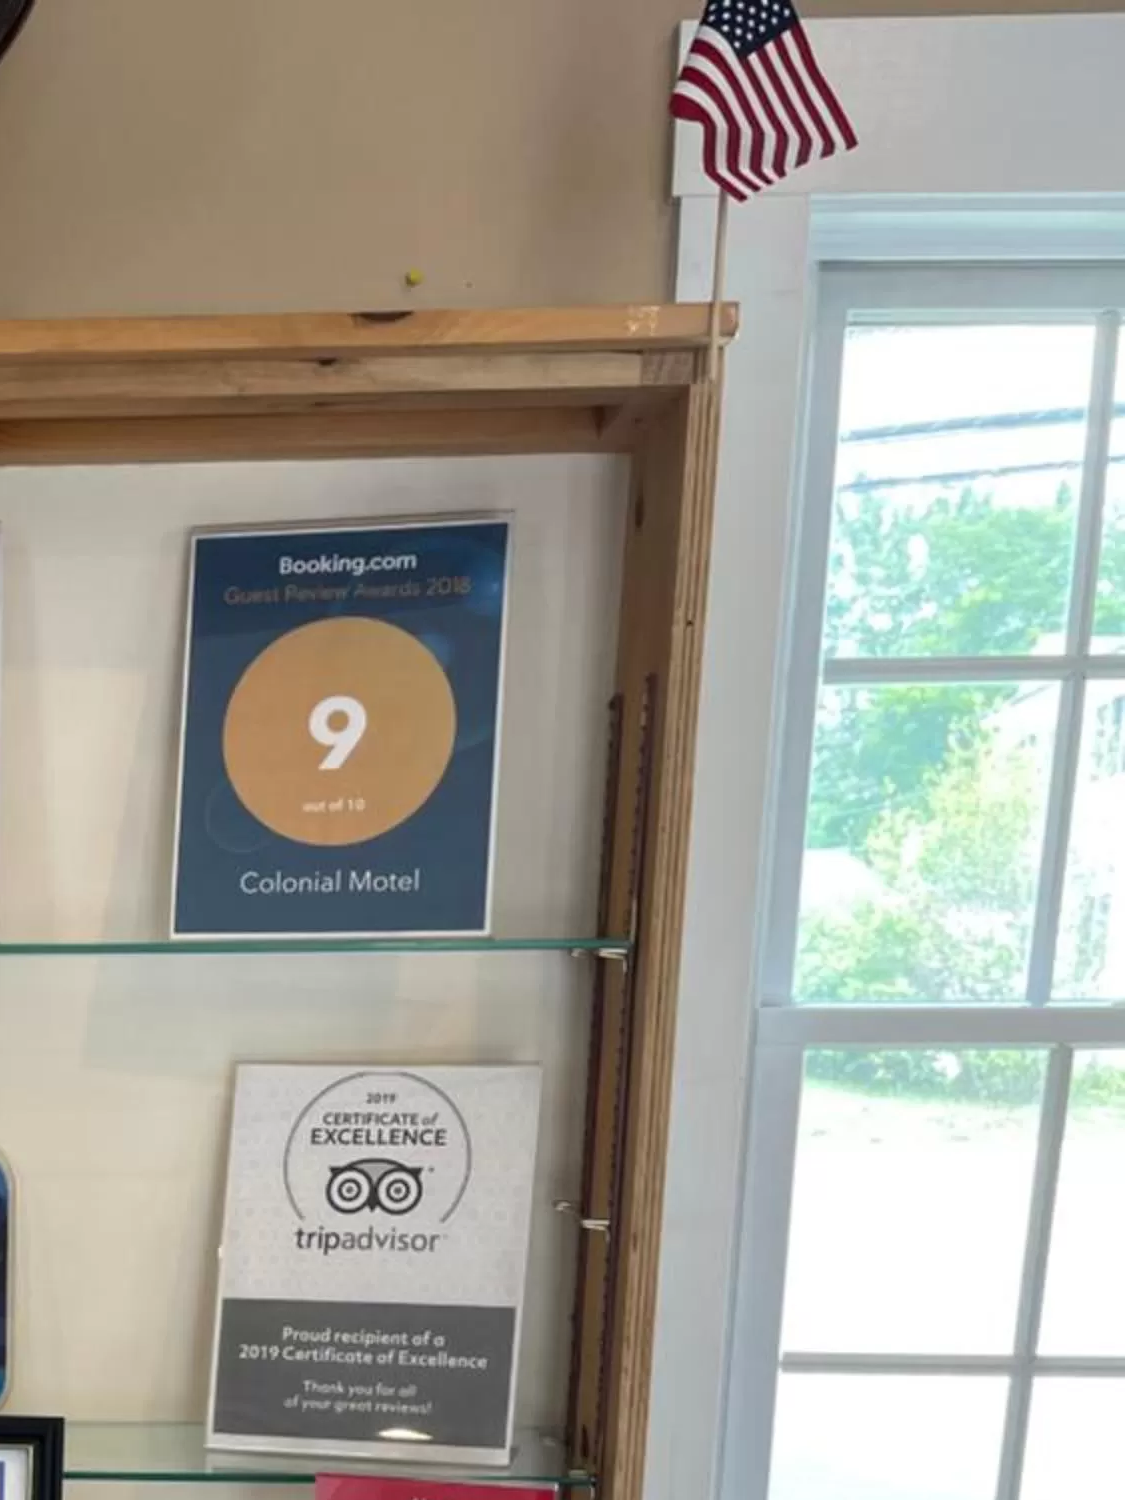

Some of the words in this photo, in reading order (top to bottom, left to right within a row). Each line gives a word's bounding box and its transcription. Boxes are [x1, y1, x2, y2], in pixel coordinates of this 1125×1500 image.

[279, 553, 417, 576] Booking.com
[224, 586, 278, 606] Guest
[284, 583, 350, 604] Review
[353, 579, 421, 600] Awards
[308, 695, 368, 772] 9
[239, 871, 341, 894] Colonial
[348, 869, 420, 893] Motel
[366, 1092, 397, 1105] 2019
[322, 1112, 419, 1126] CERTIFICATE
[421, 1112, 439, 1126] of
[310, 1128, 448, 1146] EXCELLENCE
[295, 1225, 441, 1256] tripadvisor
[282, 1326, 332, 1343] Proud
[334, 1329, 409, 1348] recipient
[411, 1330, 432, 1347] of
[433, 1335, 446, 1348] a
[239, 1343, 280, 1360] 2019
[282, 1345, 373, 1365] Certificate
[377, 1349, 394, 1366] of
[398, 1350, 489, 1370] Excellence
[303, 1380, 344, 1394] Thank
[348, 1383, 374, 1397] you
[375, 1382, 396, 1397] for
[398, 1384, 418, 1398] all
[283, 1394, 300, 1408] of
[301, 1399, 332, 1412] your
[334, 1399, 372, 1414] great
